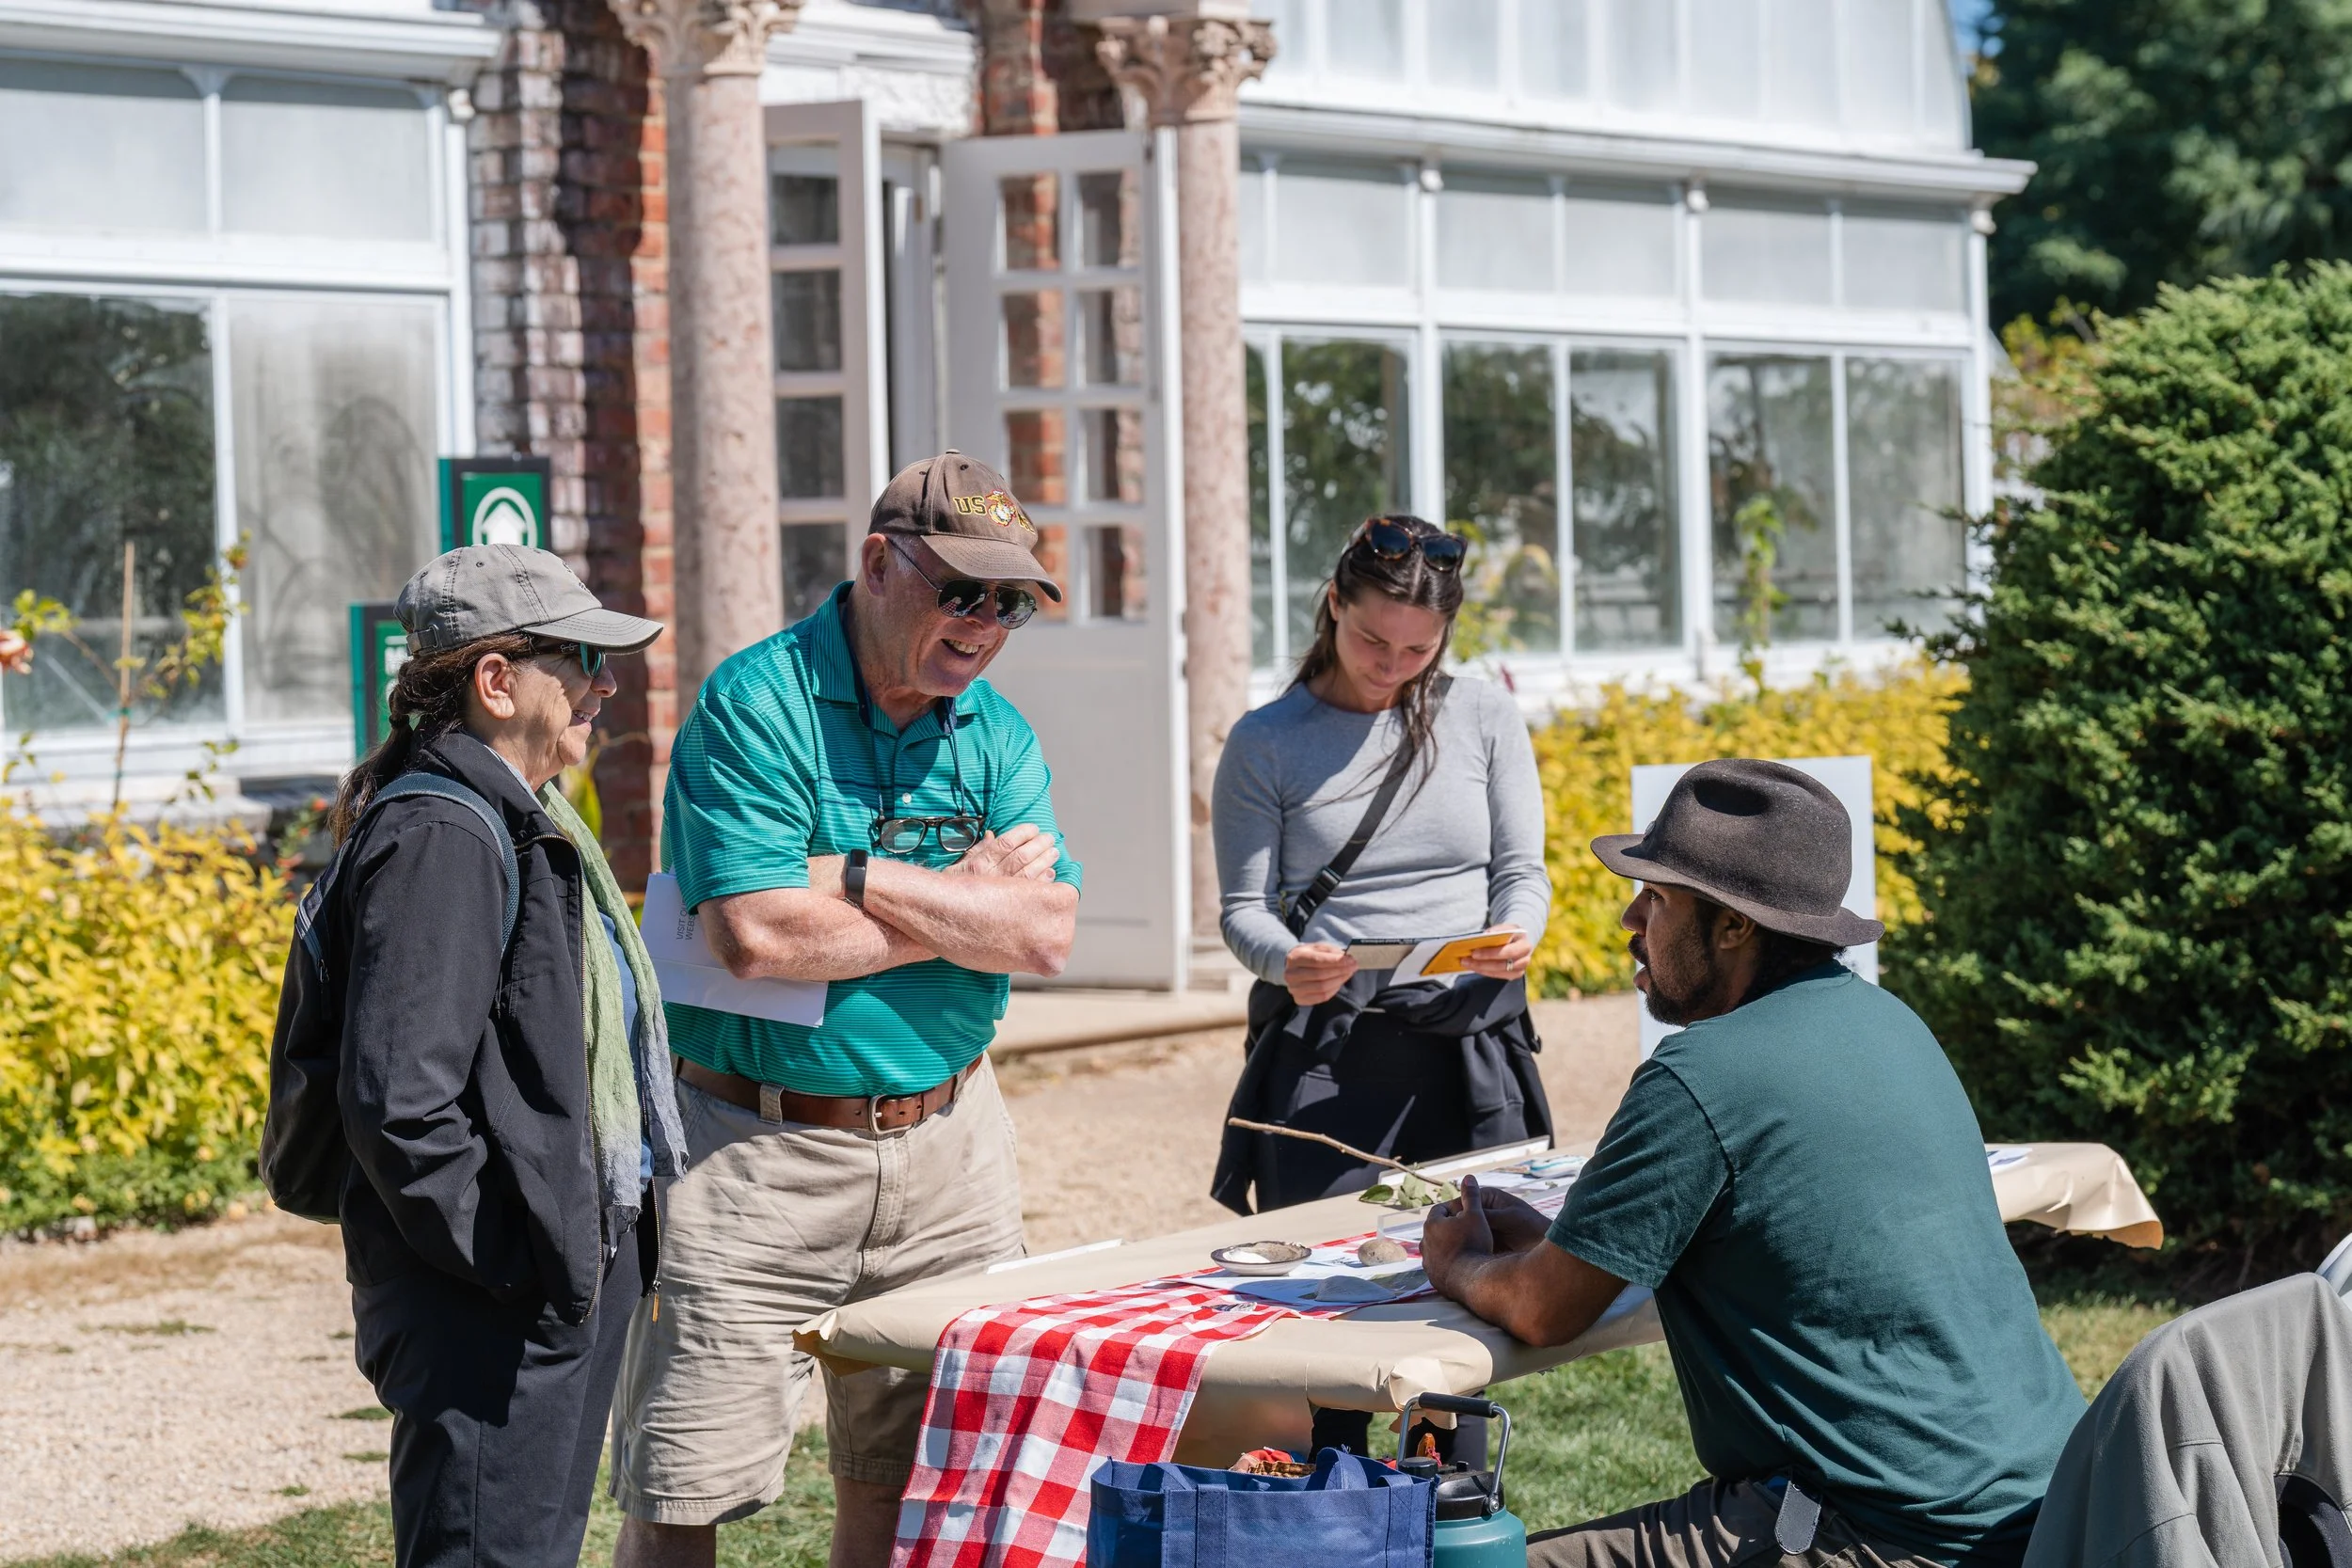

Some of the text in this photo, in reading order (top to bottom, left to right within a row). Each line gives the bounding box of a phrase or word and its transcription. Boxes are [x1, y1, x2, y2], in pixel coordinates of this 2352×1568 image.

[953, 496, 987, 515] US
[675, 918, 686, 940] VISIT
[686, 915, 696, 941] WEBS
